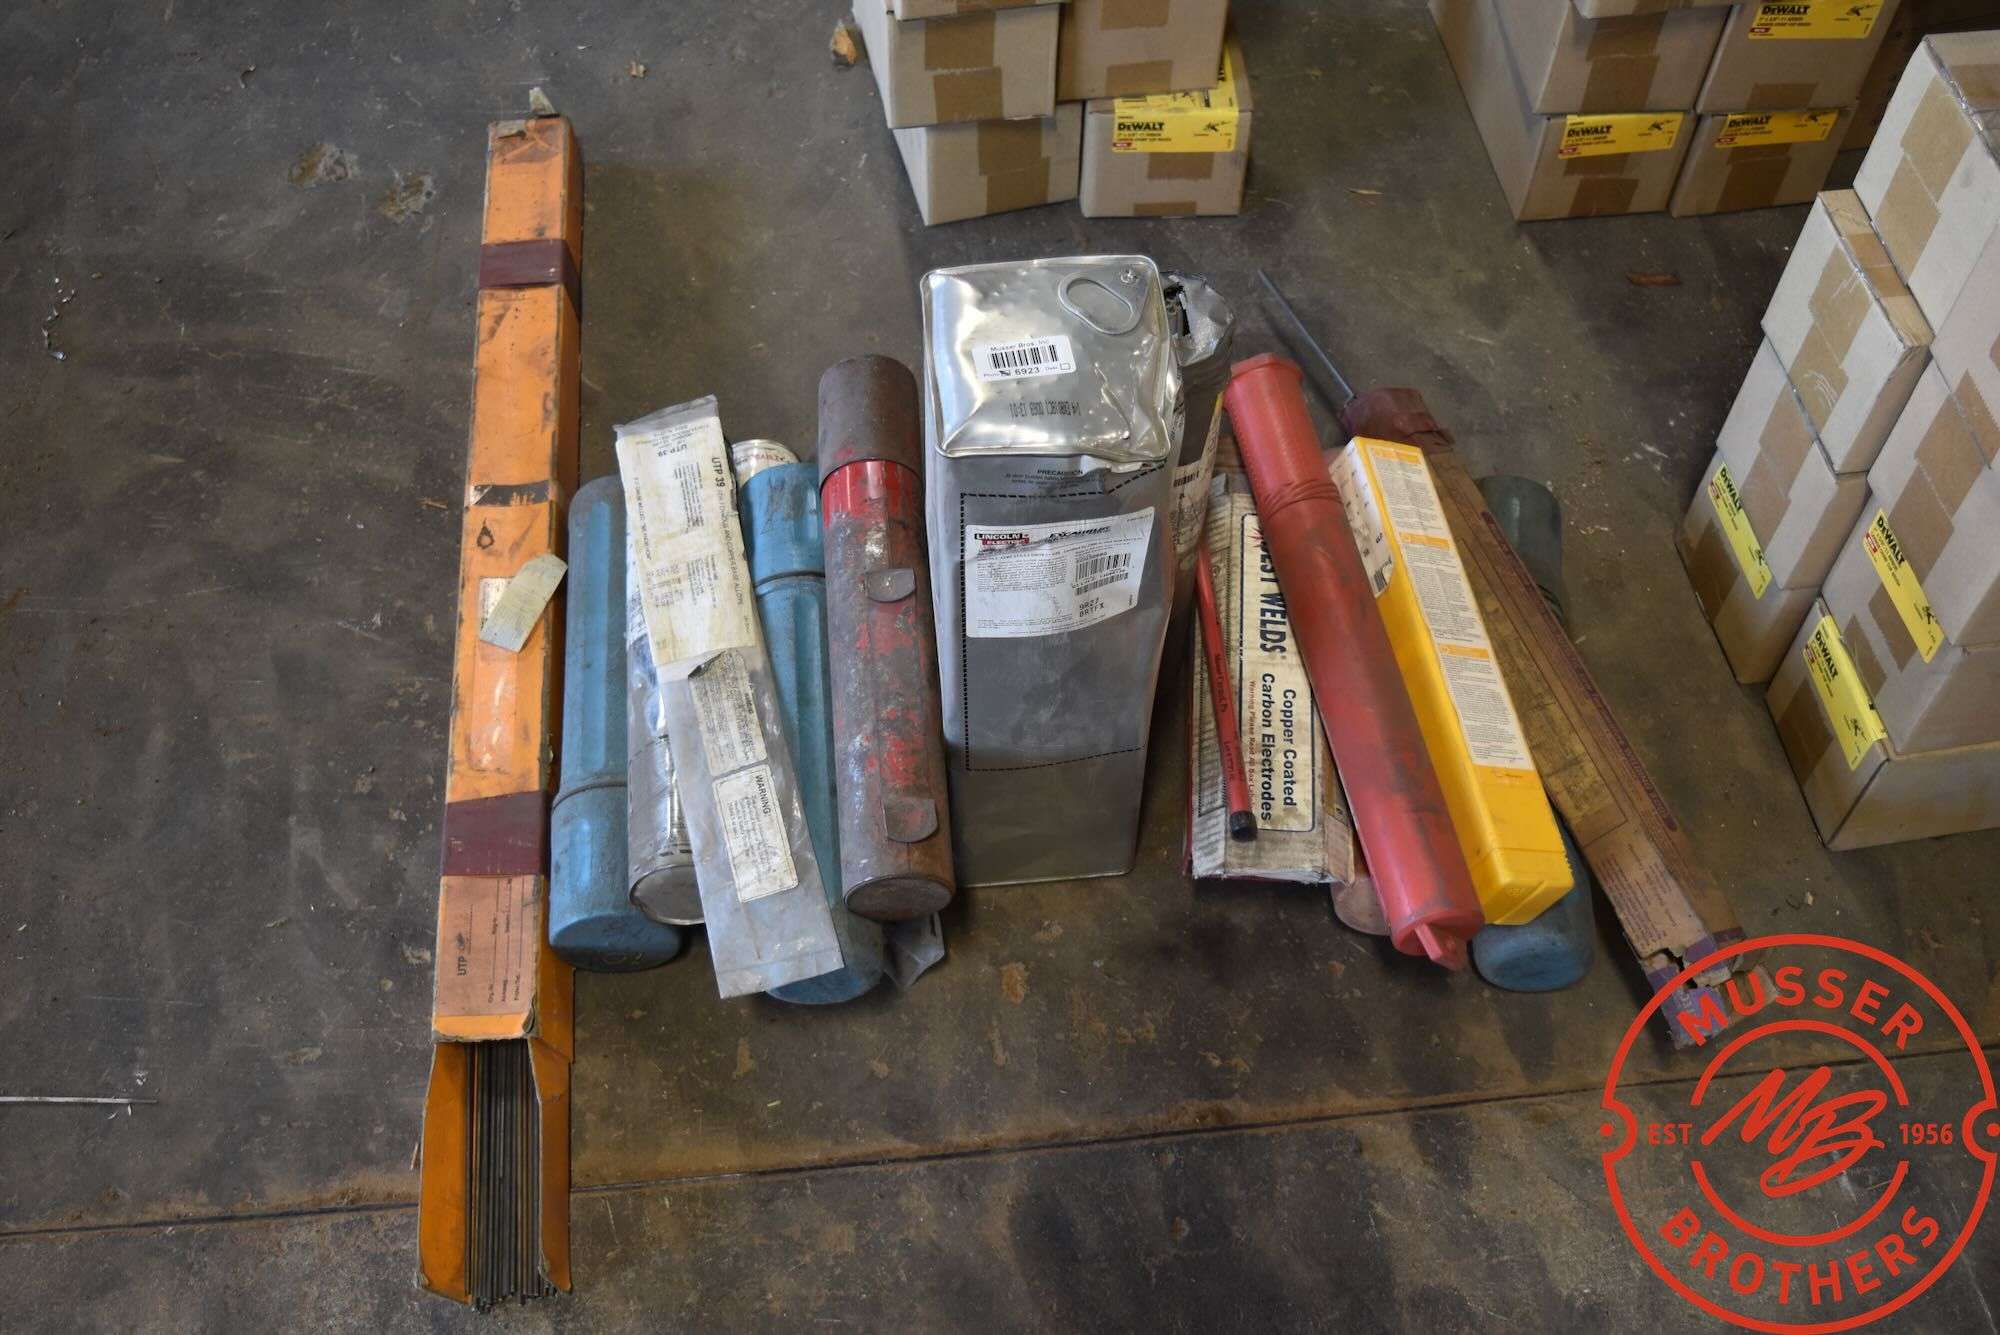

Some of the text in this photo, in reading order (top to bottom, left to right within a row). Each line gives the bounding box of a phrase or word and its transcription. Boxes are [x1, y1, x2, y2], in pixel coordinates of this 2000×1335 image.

[1014, 366, 1040, 375] 6923
[669, 443, 686, 452] UTP
[711, 456, 722, 475] UTP
[714, 476, 725, 487] 39
[1259, 591, 1287, 656] WELDS
[1259, 672, 1275, 822] Carbon Electrodes
[1282, 688, 1297, 811] Copper Coated
[754, 774, 771, 815] WARNING
[458, 956, 467, 976] UTP
